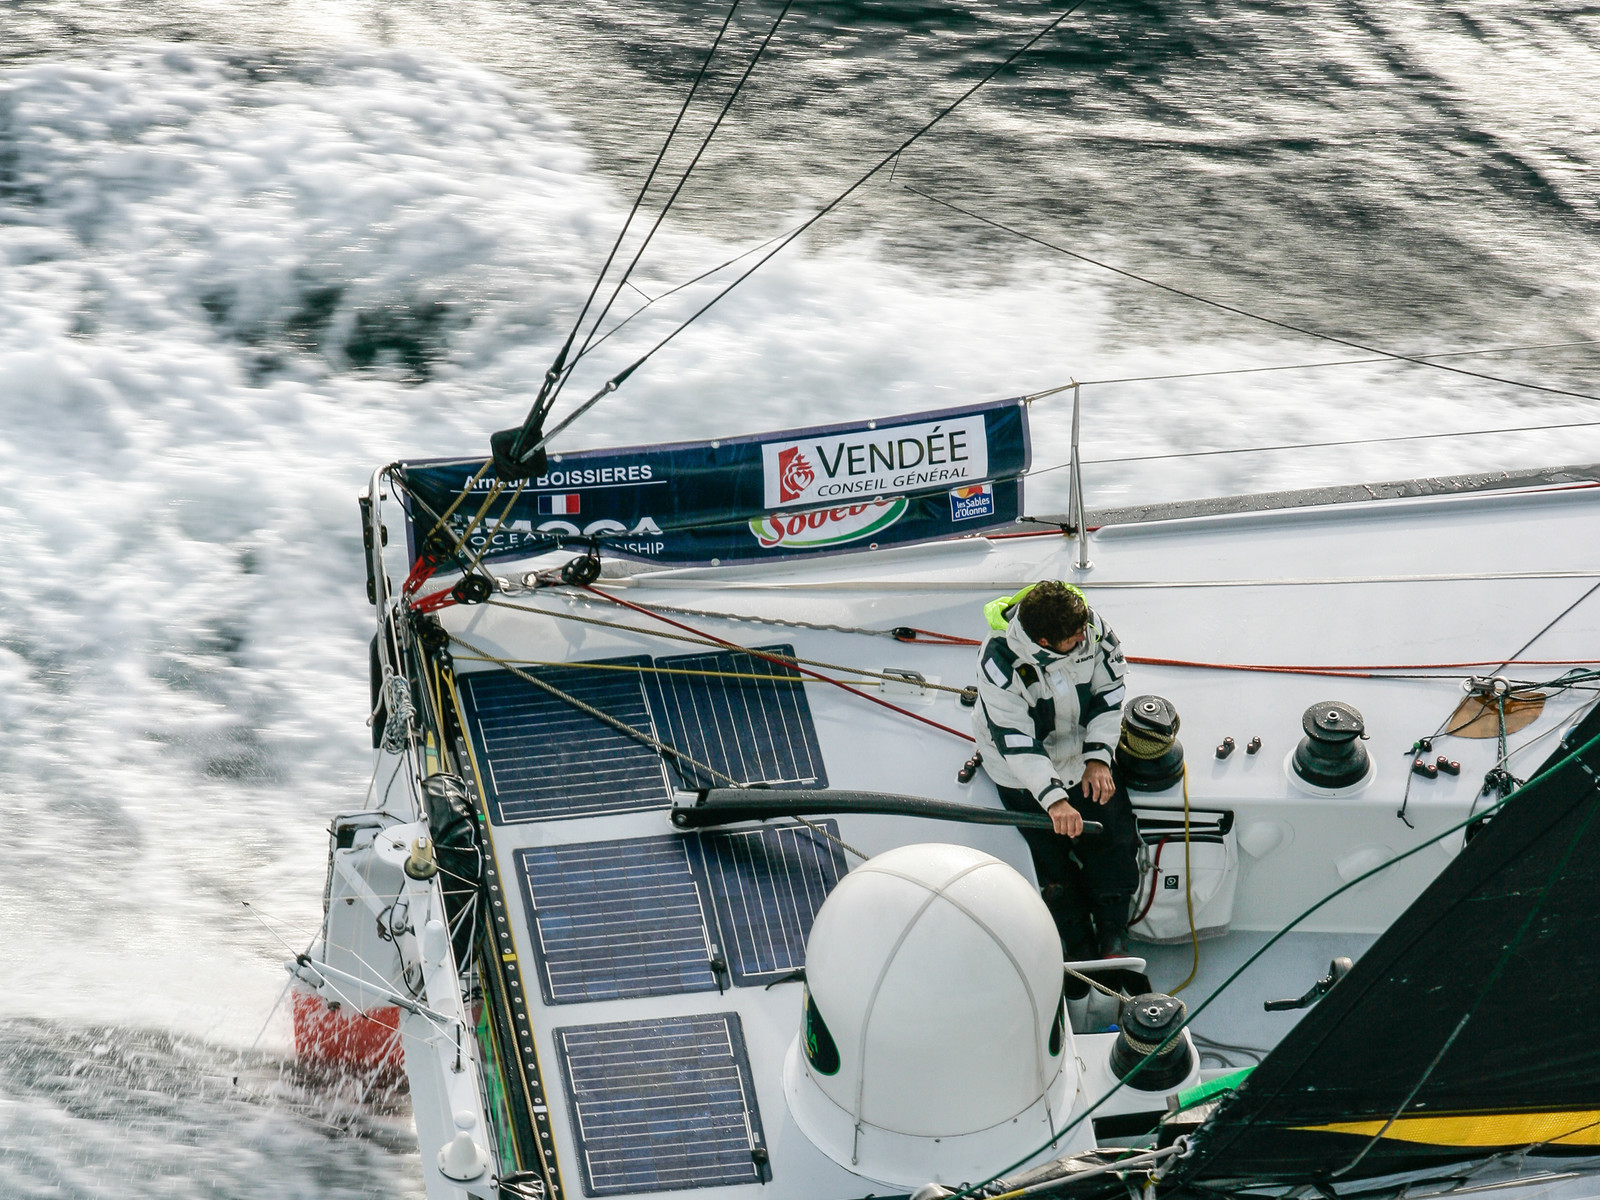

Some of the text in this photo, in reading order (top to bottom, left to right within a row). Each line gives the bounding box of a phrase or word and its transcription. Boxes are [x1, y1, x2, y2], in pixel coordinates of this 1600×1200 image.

[815, 424, 970, 479] VENDÉE
[536, 464, 653, 487] BOISSIERES
[817, 466, 969, 497] CONSEIL GÉNÉRAL
[954, 506, 988, 518] d'Olonne
[965, 496, 991, 508] Sables
